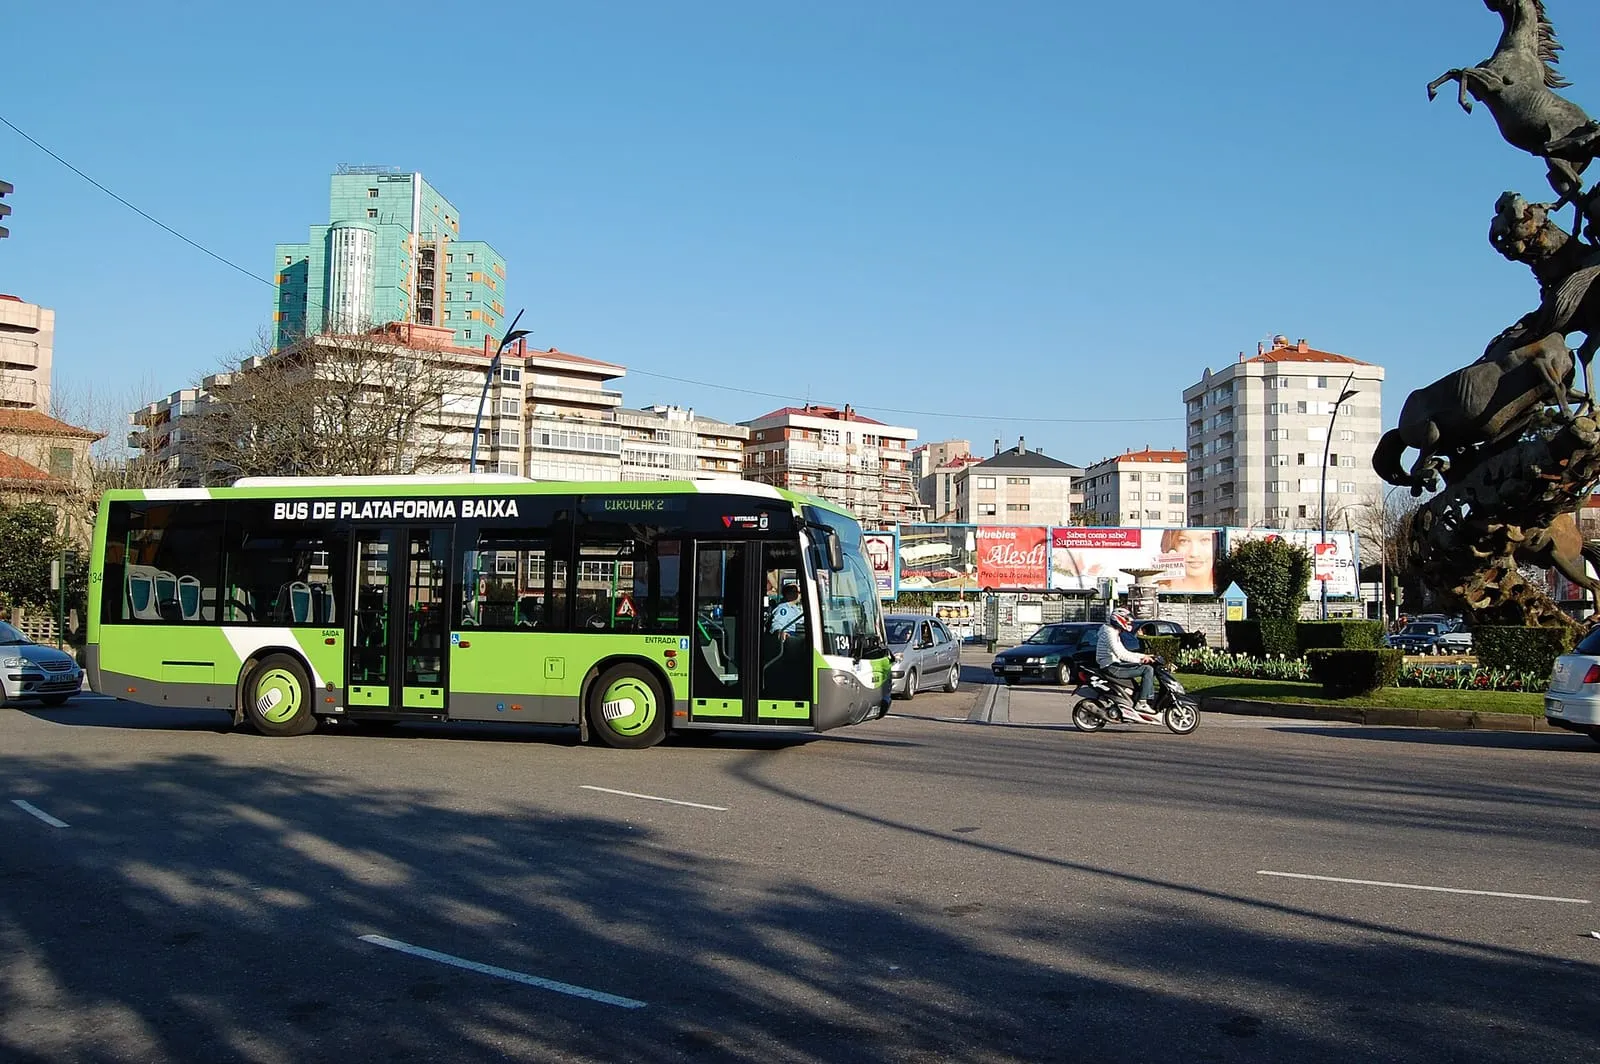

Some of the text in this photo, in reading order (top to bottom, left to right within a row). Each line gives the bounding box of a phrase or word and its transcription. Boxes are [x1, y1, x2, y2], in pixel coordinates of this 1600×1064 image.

[273, 499, 519, 520] BUS DE PLATAFORMA BAIXA
[604, 499, 664, 510] CIRCULAR 2
[975, 529, 1017, 539] Muebles
[1066, 531, 1087, 539] Sabes
[982, 543, 1046, 566] Alesdi
[1152, 562, 1184, 570] SUPREMA
[644, 636, 677, 644] ENTRADA
[835, 635, 850, 650] 134
